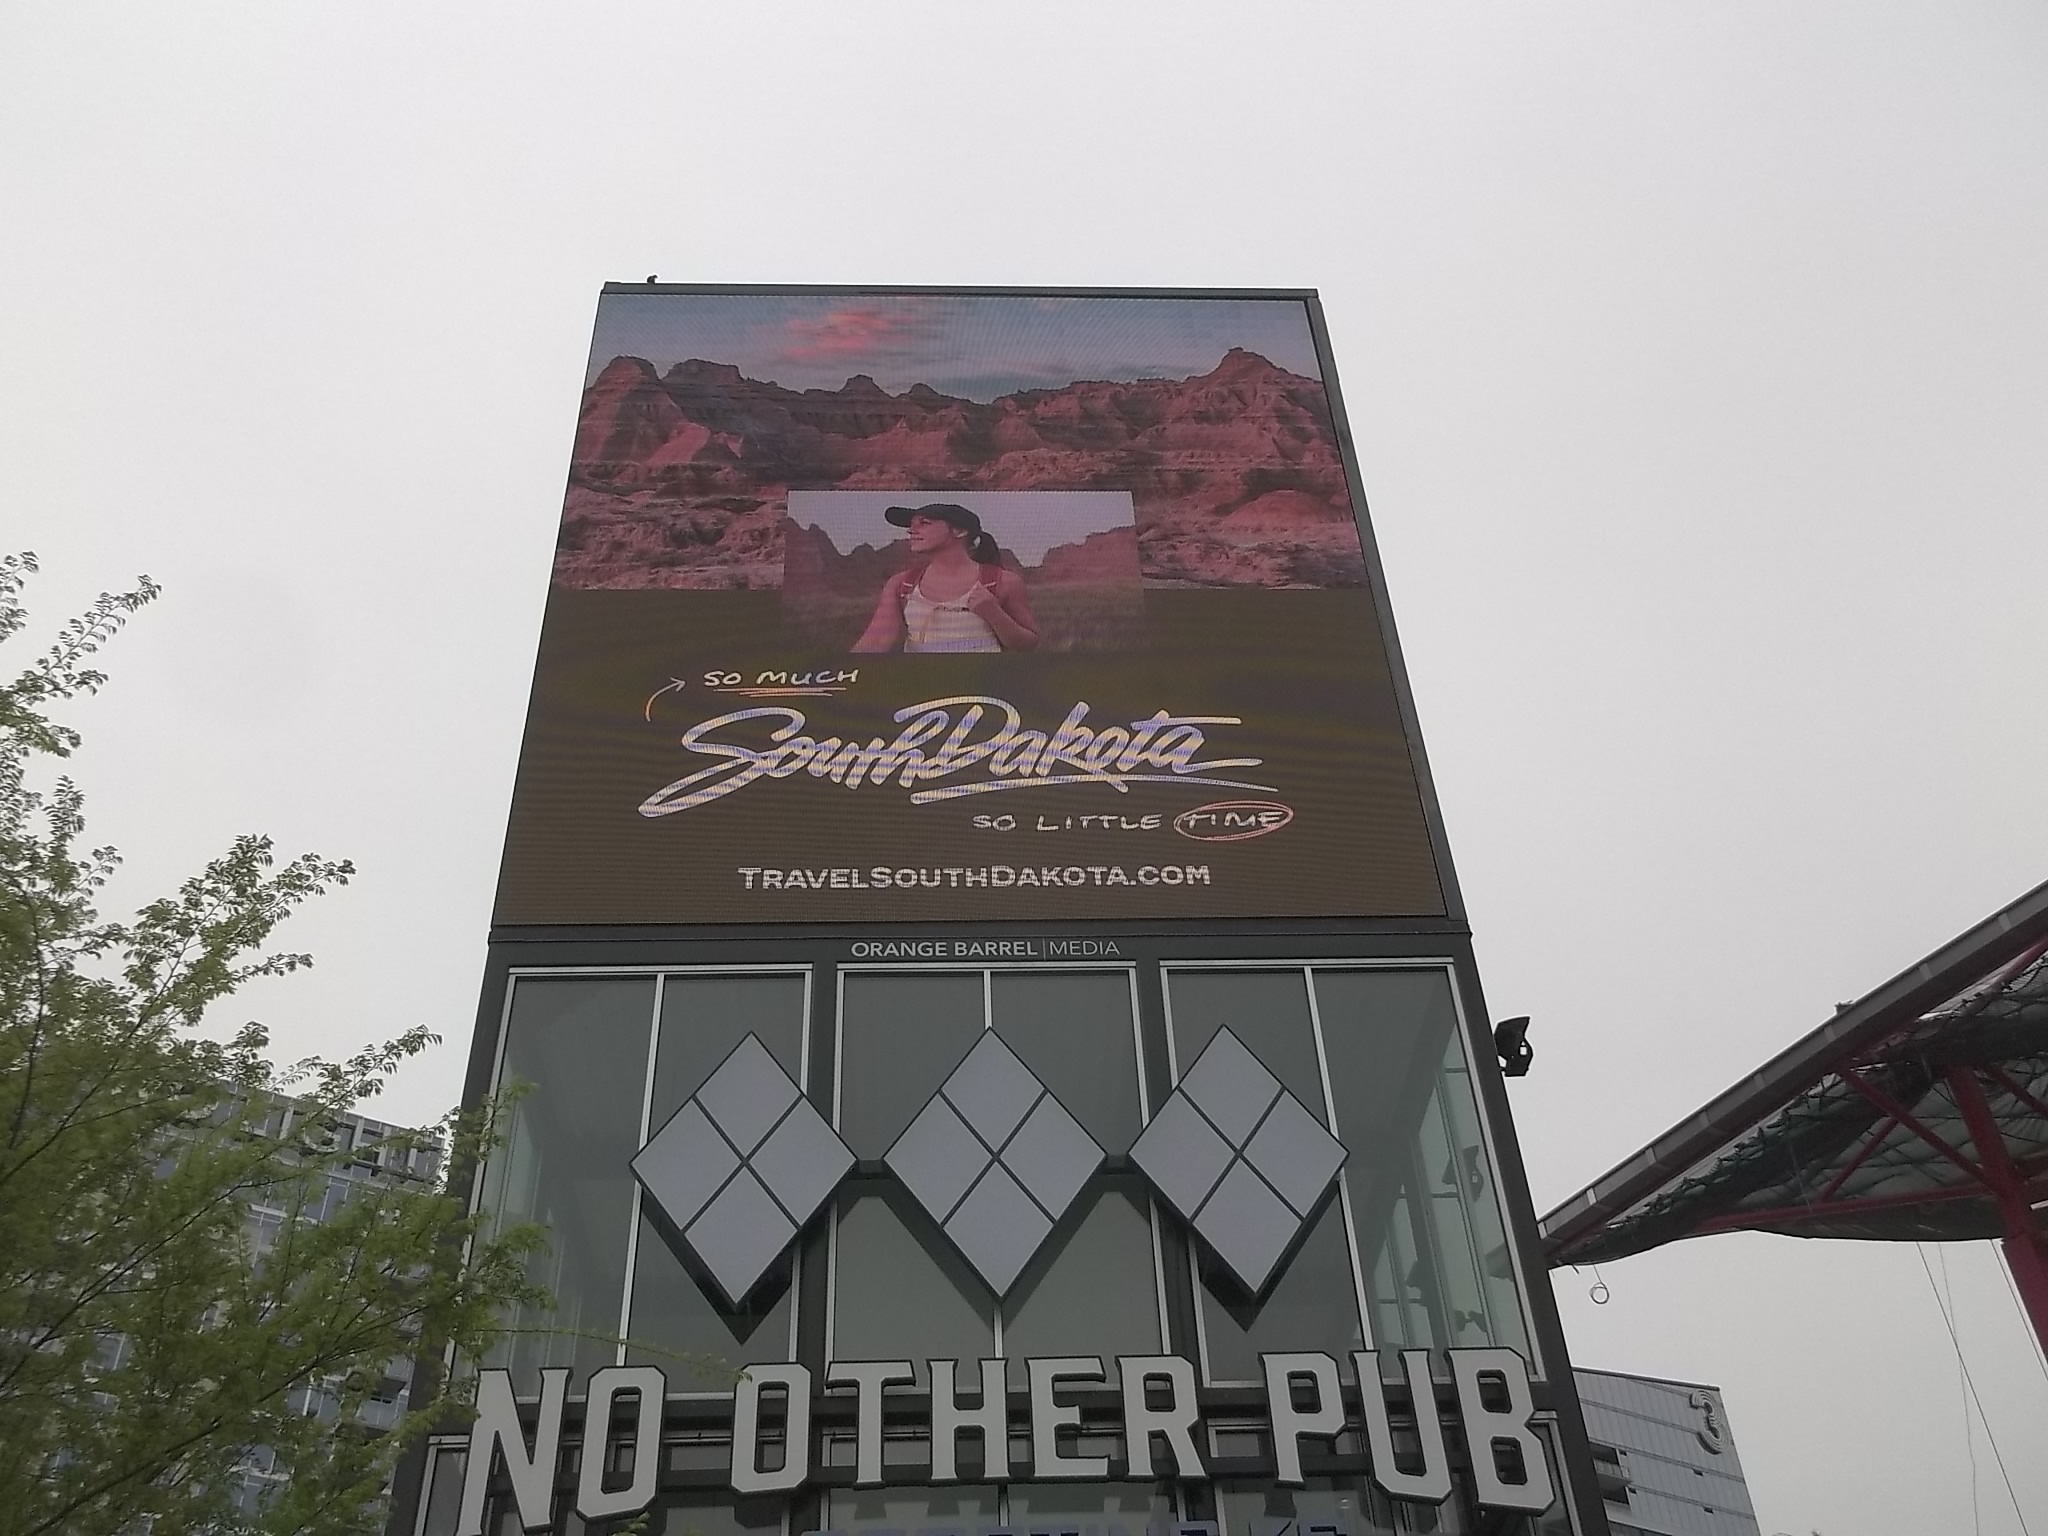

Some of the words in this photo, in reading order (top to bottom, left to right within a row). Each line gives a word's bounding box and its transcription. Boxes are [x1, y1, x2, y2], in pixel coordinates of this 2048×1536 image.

[704, 670, 741, 687] SO
[756, 669, 859, 686] MUCH
[972, 814, 1016, 832] SO
[1036, 814, 1162, 831] LITTLE
[1184, 811, 1283, 829] TIME
[737, 865, 1212, 890] TRAVELSOUTHDAKOTA.COM
[851, 942, 948, 957] ORANGE
[954, 941, 1038, 956] BARREL
[1050, 940, 1120, 955] MEDIA
[455, 1365, 667, 1535] NO
[729, 1355, 1206, 1493] OTHER
[1258, 1347, 1556, 1516] PUB
